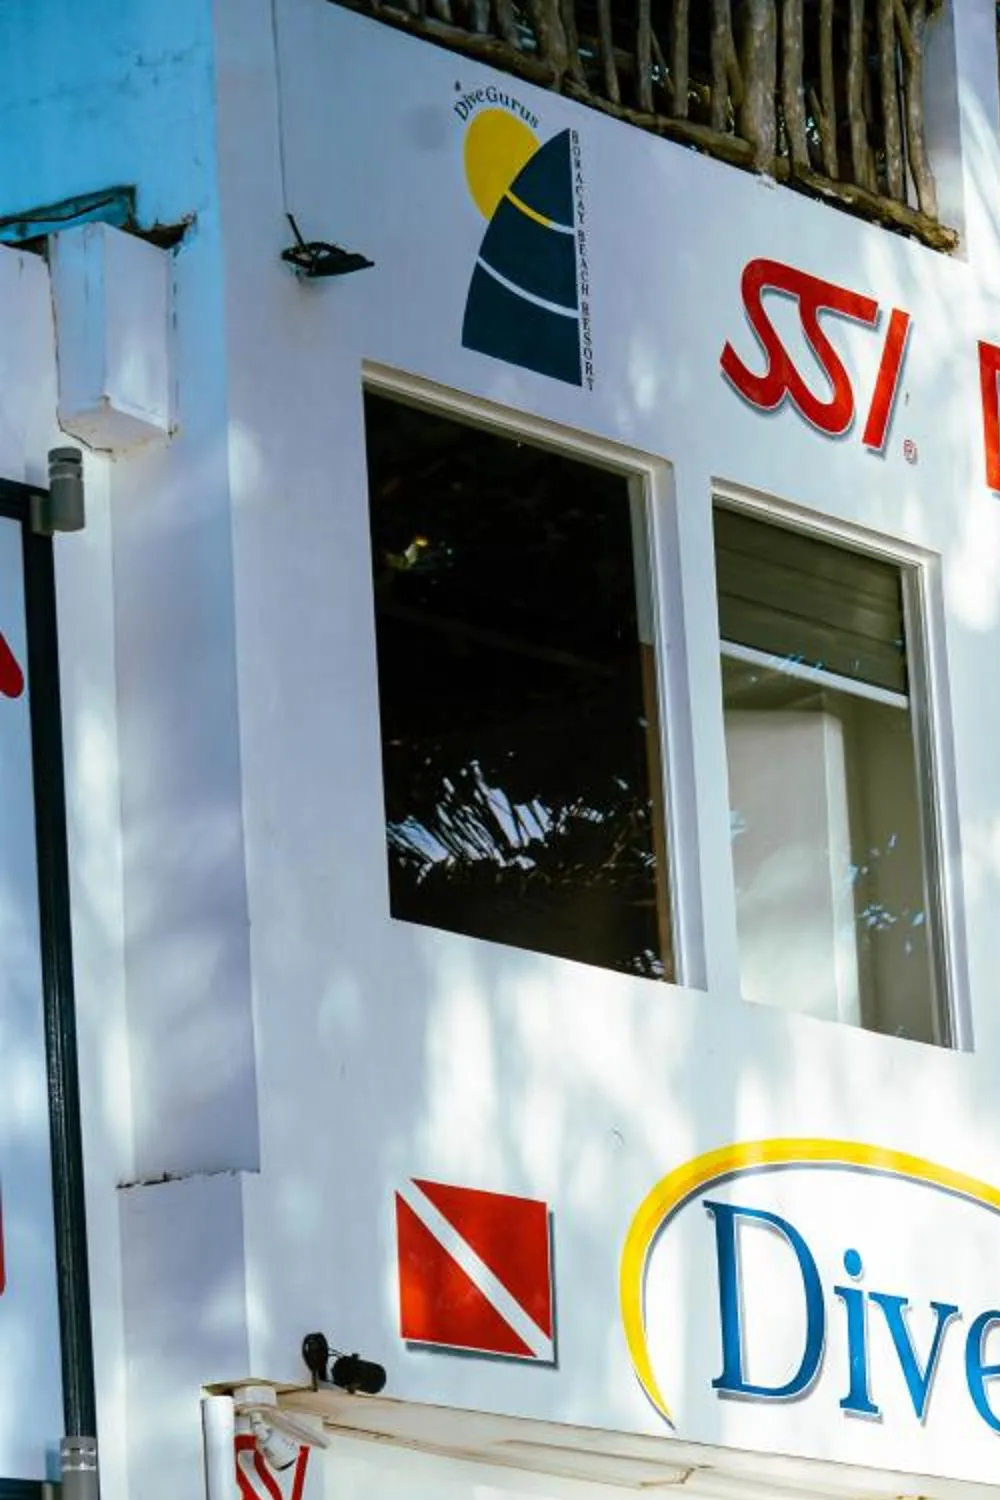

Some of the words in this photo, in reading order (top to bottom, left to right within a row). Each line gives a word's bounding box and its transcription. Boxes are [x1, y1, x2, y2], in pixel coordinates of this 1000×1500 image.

[454, 86, 540, 129] DiveGurus
[571, 129, 586, 224] BORACAY
[577, 229, 590, 296] BEACH
[580, 301, 595, 391] RESORT
[720, 256, 911, 452] SSI
